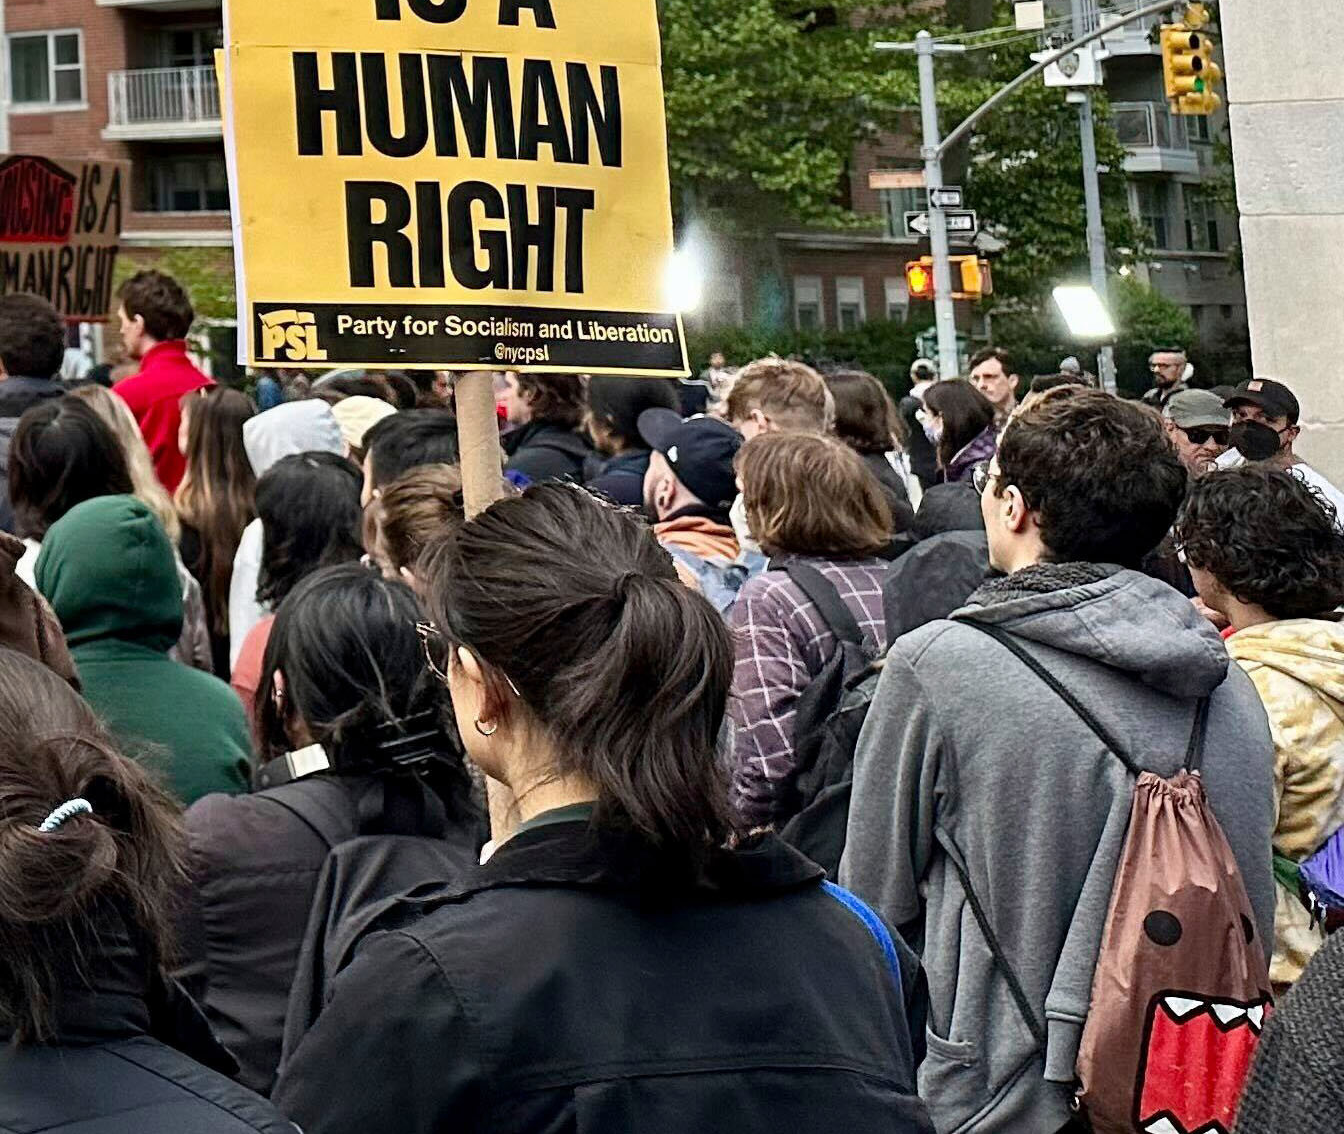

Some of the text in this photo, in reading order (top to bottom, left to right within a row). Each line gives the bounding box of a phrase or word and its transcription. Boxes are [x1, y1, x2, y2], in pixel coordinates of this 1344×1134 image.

[291, 50, 623, 169] HUMAN
[75, 164, 101, 234] IS
[99, 167, 122, 236] A
[344, 179, 595, 294] RIGHT
[56, 244, 119, 316] RIGHT
[261, 321, 327, 361] PSL
[337, 314, 675, 344] Party for Socialism and Liberation
[494, 342, 550, 363] @nycpsl
